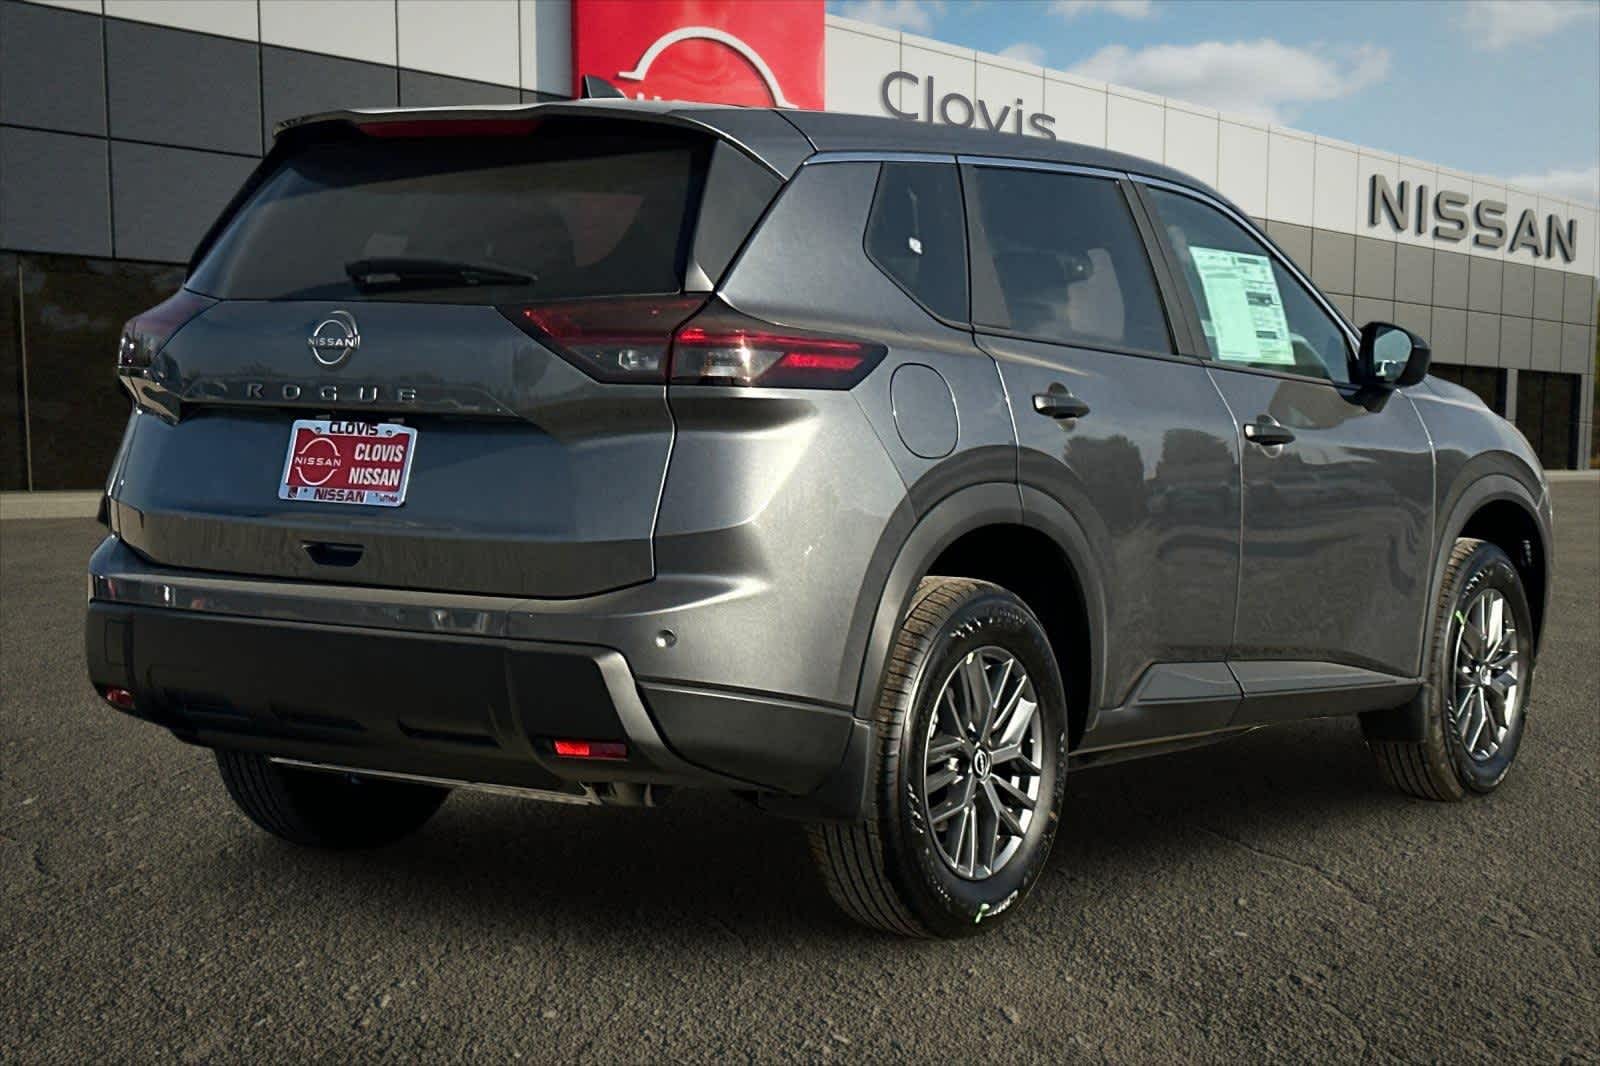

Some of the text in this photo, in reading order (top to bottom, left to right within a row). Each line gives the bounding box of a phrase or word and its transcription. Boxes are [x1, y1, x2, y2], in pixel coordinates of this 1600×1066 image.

[881, 70, 1057, 140] Clovis
[1368, 174, 1578, 263] NISSAN
[307, 336, 357, 348] NISSAN
[246, 383, 417, 402] ROGUE
[329, 421, 379, 436] CLOVIS
[295, 456, 342, 467] NISSAN
[354, 443, 406, 463] CLOVIS
[348, 467, 401, 486] NISSAN
[314, 488, 367, 503] NISSAN
